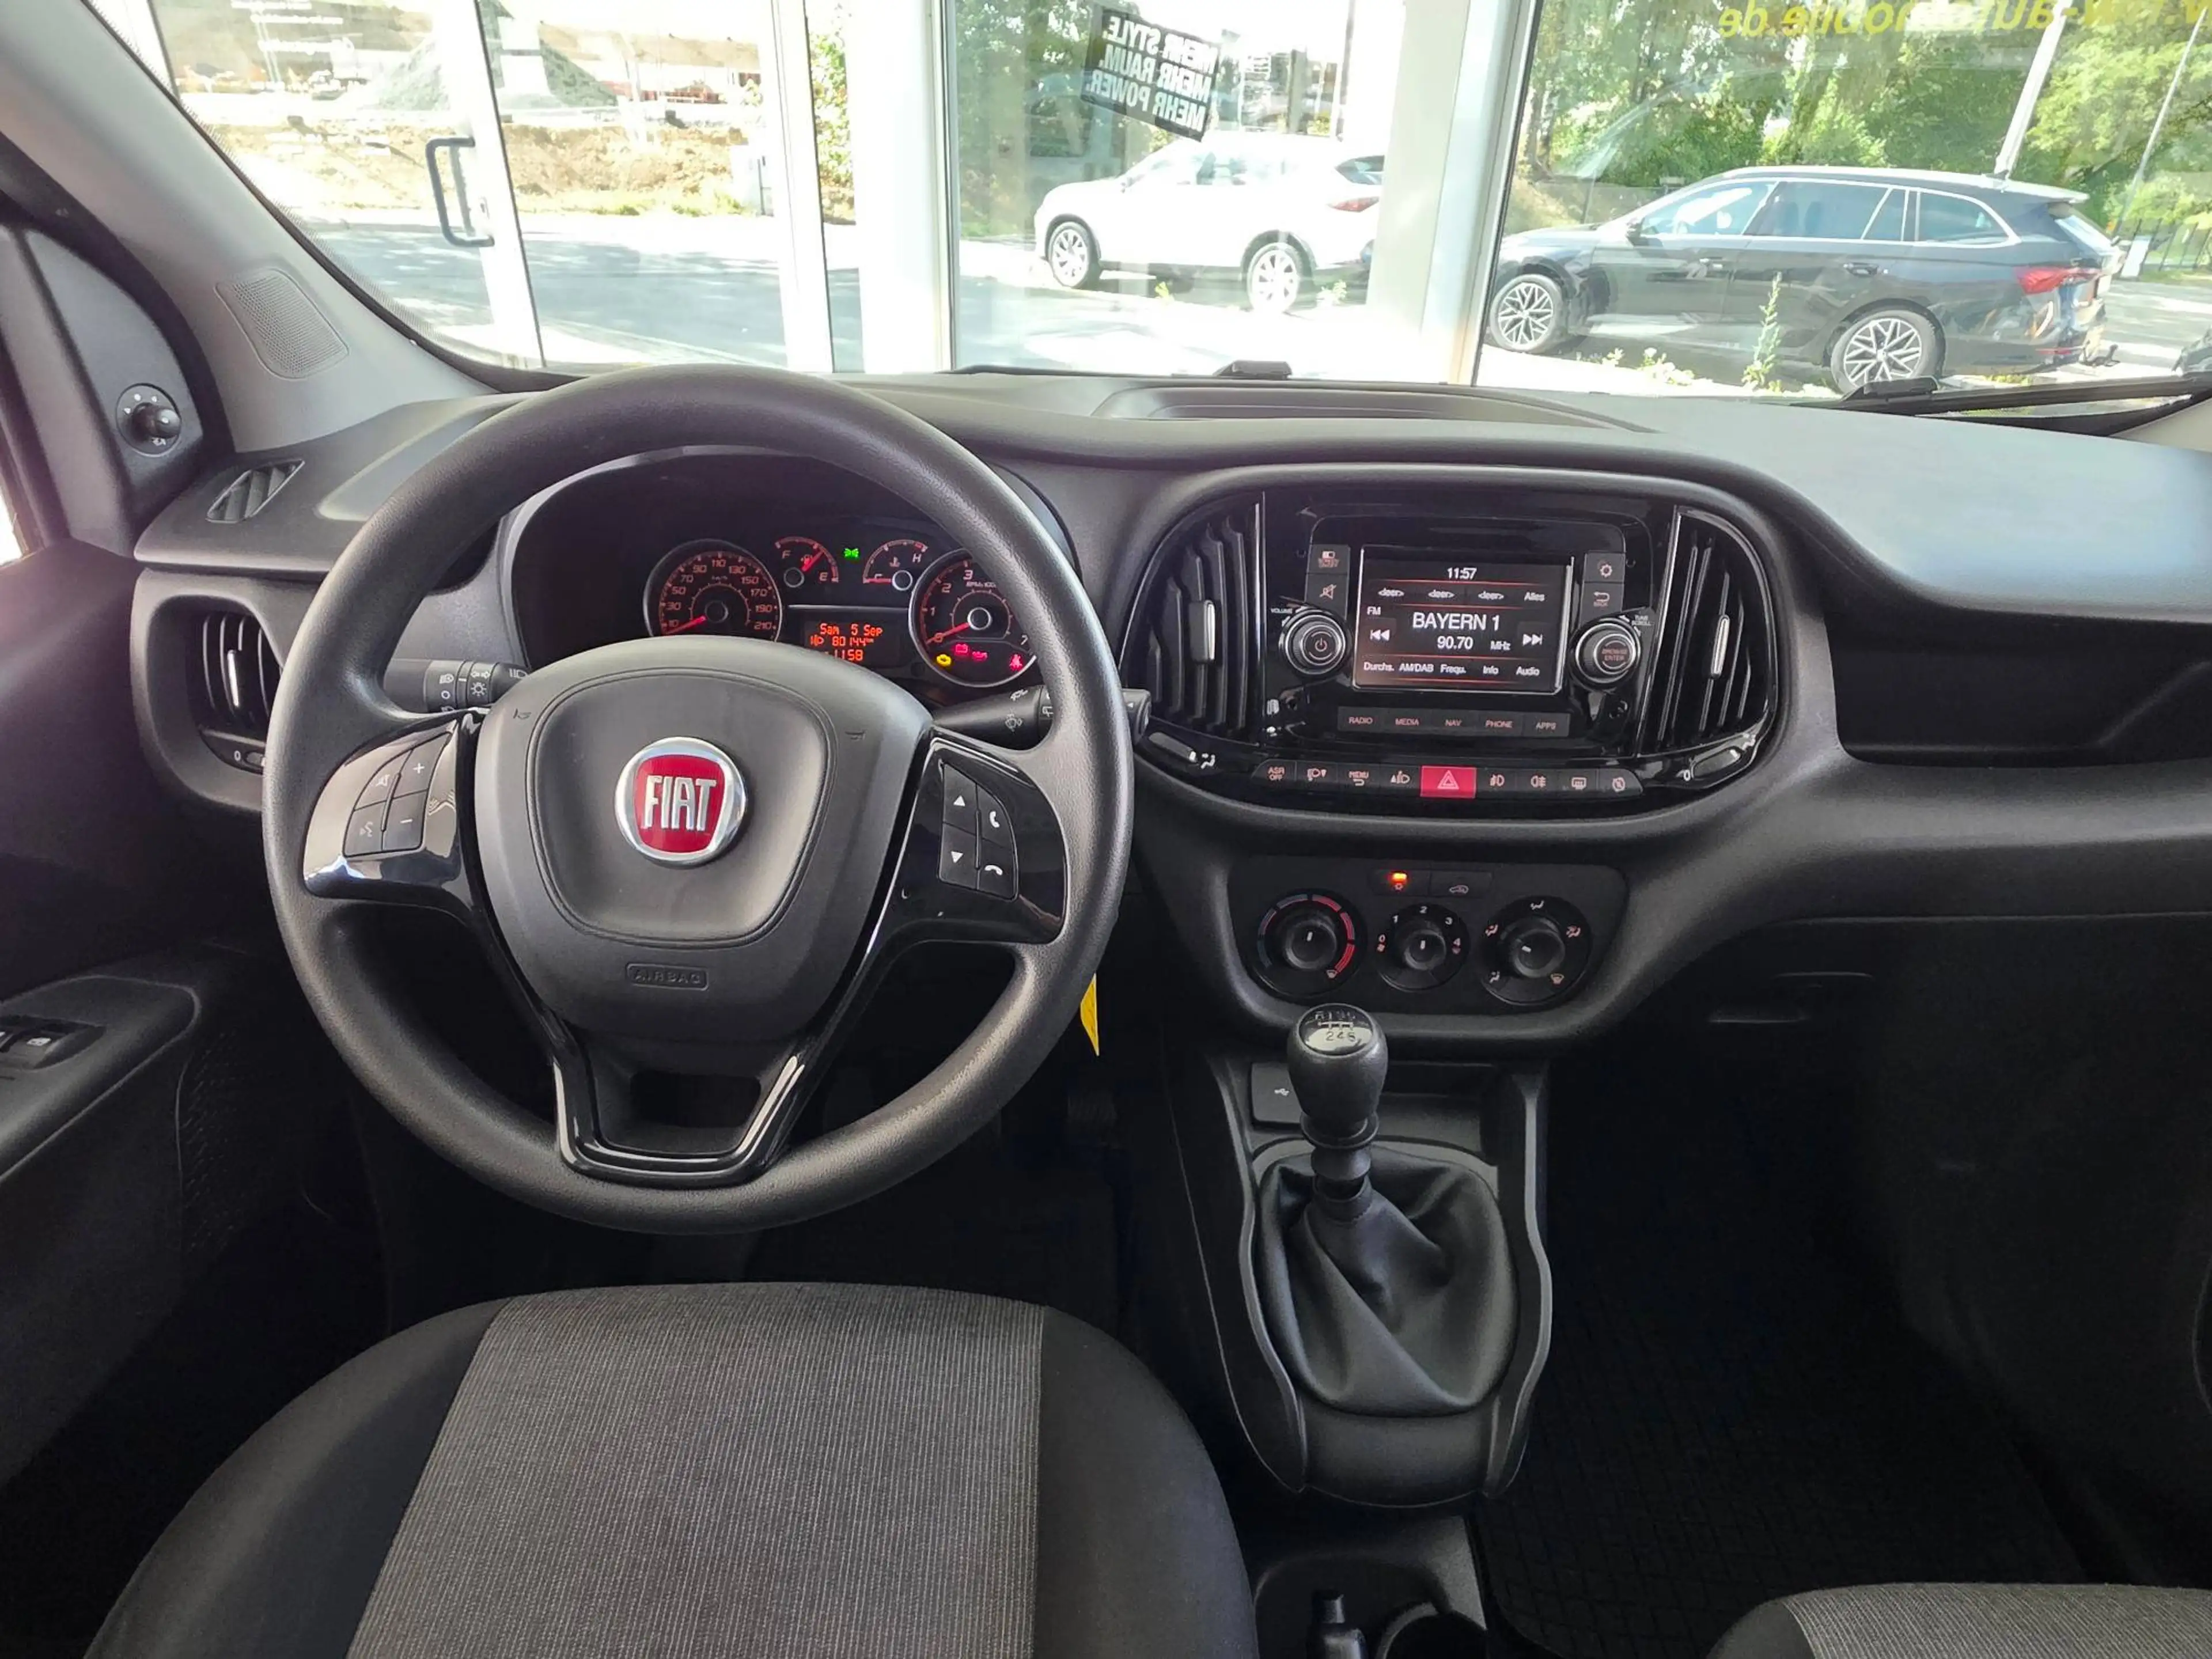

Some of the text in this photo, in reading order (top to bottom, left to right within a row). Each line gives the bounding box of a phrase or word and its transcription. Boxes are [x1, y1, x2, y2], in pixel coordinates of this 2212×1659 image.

[782, 550, 791, 559] F
[912, 554, 922, 563] H
[711, 559, 726, 567] 110
[693, 565, 707, 573] 90
[729, 566, 745, 574] 130
[1447, 567, 1477, 579] 11:57
[681, 574, 694, 583] 70
[819, 572, 828, 581] E
[963, 570, 973, 580] 3
[741, 576, 759, 584] 150
[672, 586, 686, 595] 50
[941, 583, 952, 593] 2
[751, 589, 768, 597] 170
[666, 602, 681, 611] 30
[755, 604, 772, 612] 190
[1367, 607, 1381, 615] FM
[930, 607, 935, 616] 1
[754, 622, 772, 630] 210
[1412, 612, 1499, 631] BAYERN 1
[851, 623, 858, 635] 5
[863, 624, 882, 637] Sep
[1437, 636, 1512, 651] 90.70 MHz
[1363, 662, 1394, 672] Durchs.
[1399, 664, 1434, 673] AM/DAB
[1483, 666, 1499, 675] Info
[1516, 666, 1540, 676] Audio
[1349, 716, 1556, 730] RADIO MEDIA NAV PHONE APPS
[641, 775, 717, 832] FIAT
[1419, 906, 1427, 914] 2
[1392, 915, 1399, 924] 1
[1445, 916, 1453, 925] 3
[1453, 938, 1461, 946] 4
[635, 970, 701, 984] AIRBAG
[1326, 1031, 1334, 1041] 2
